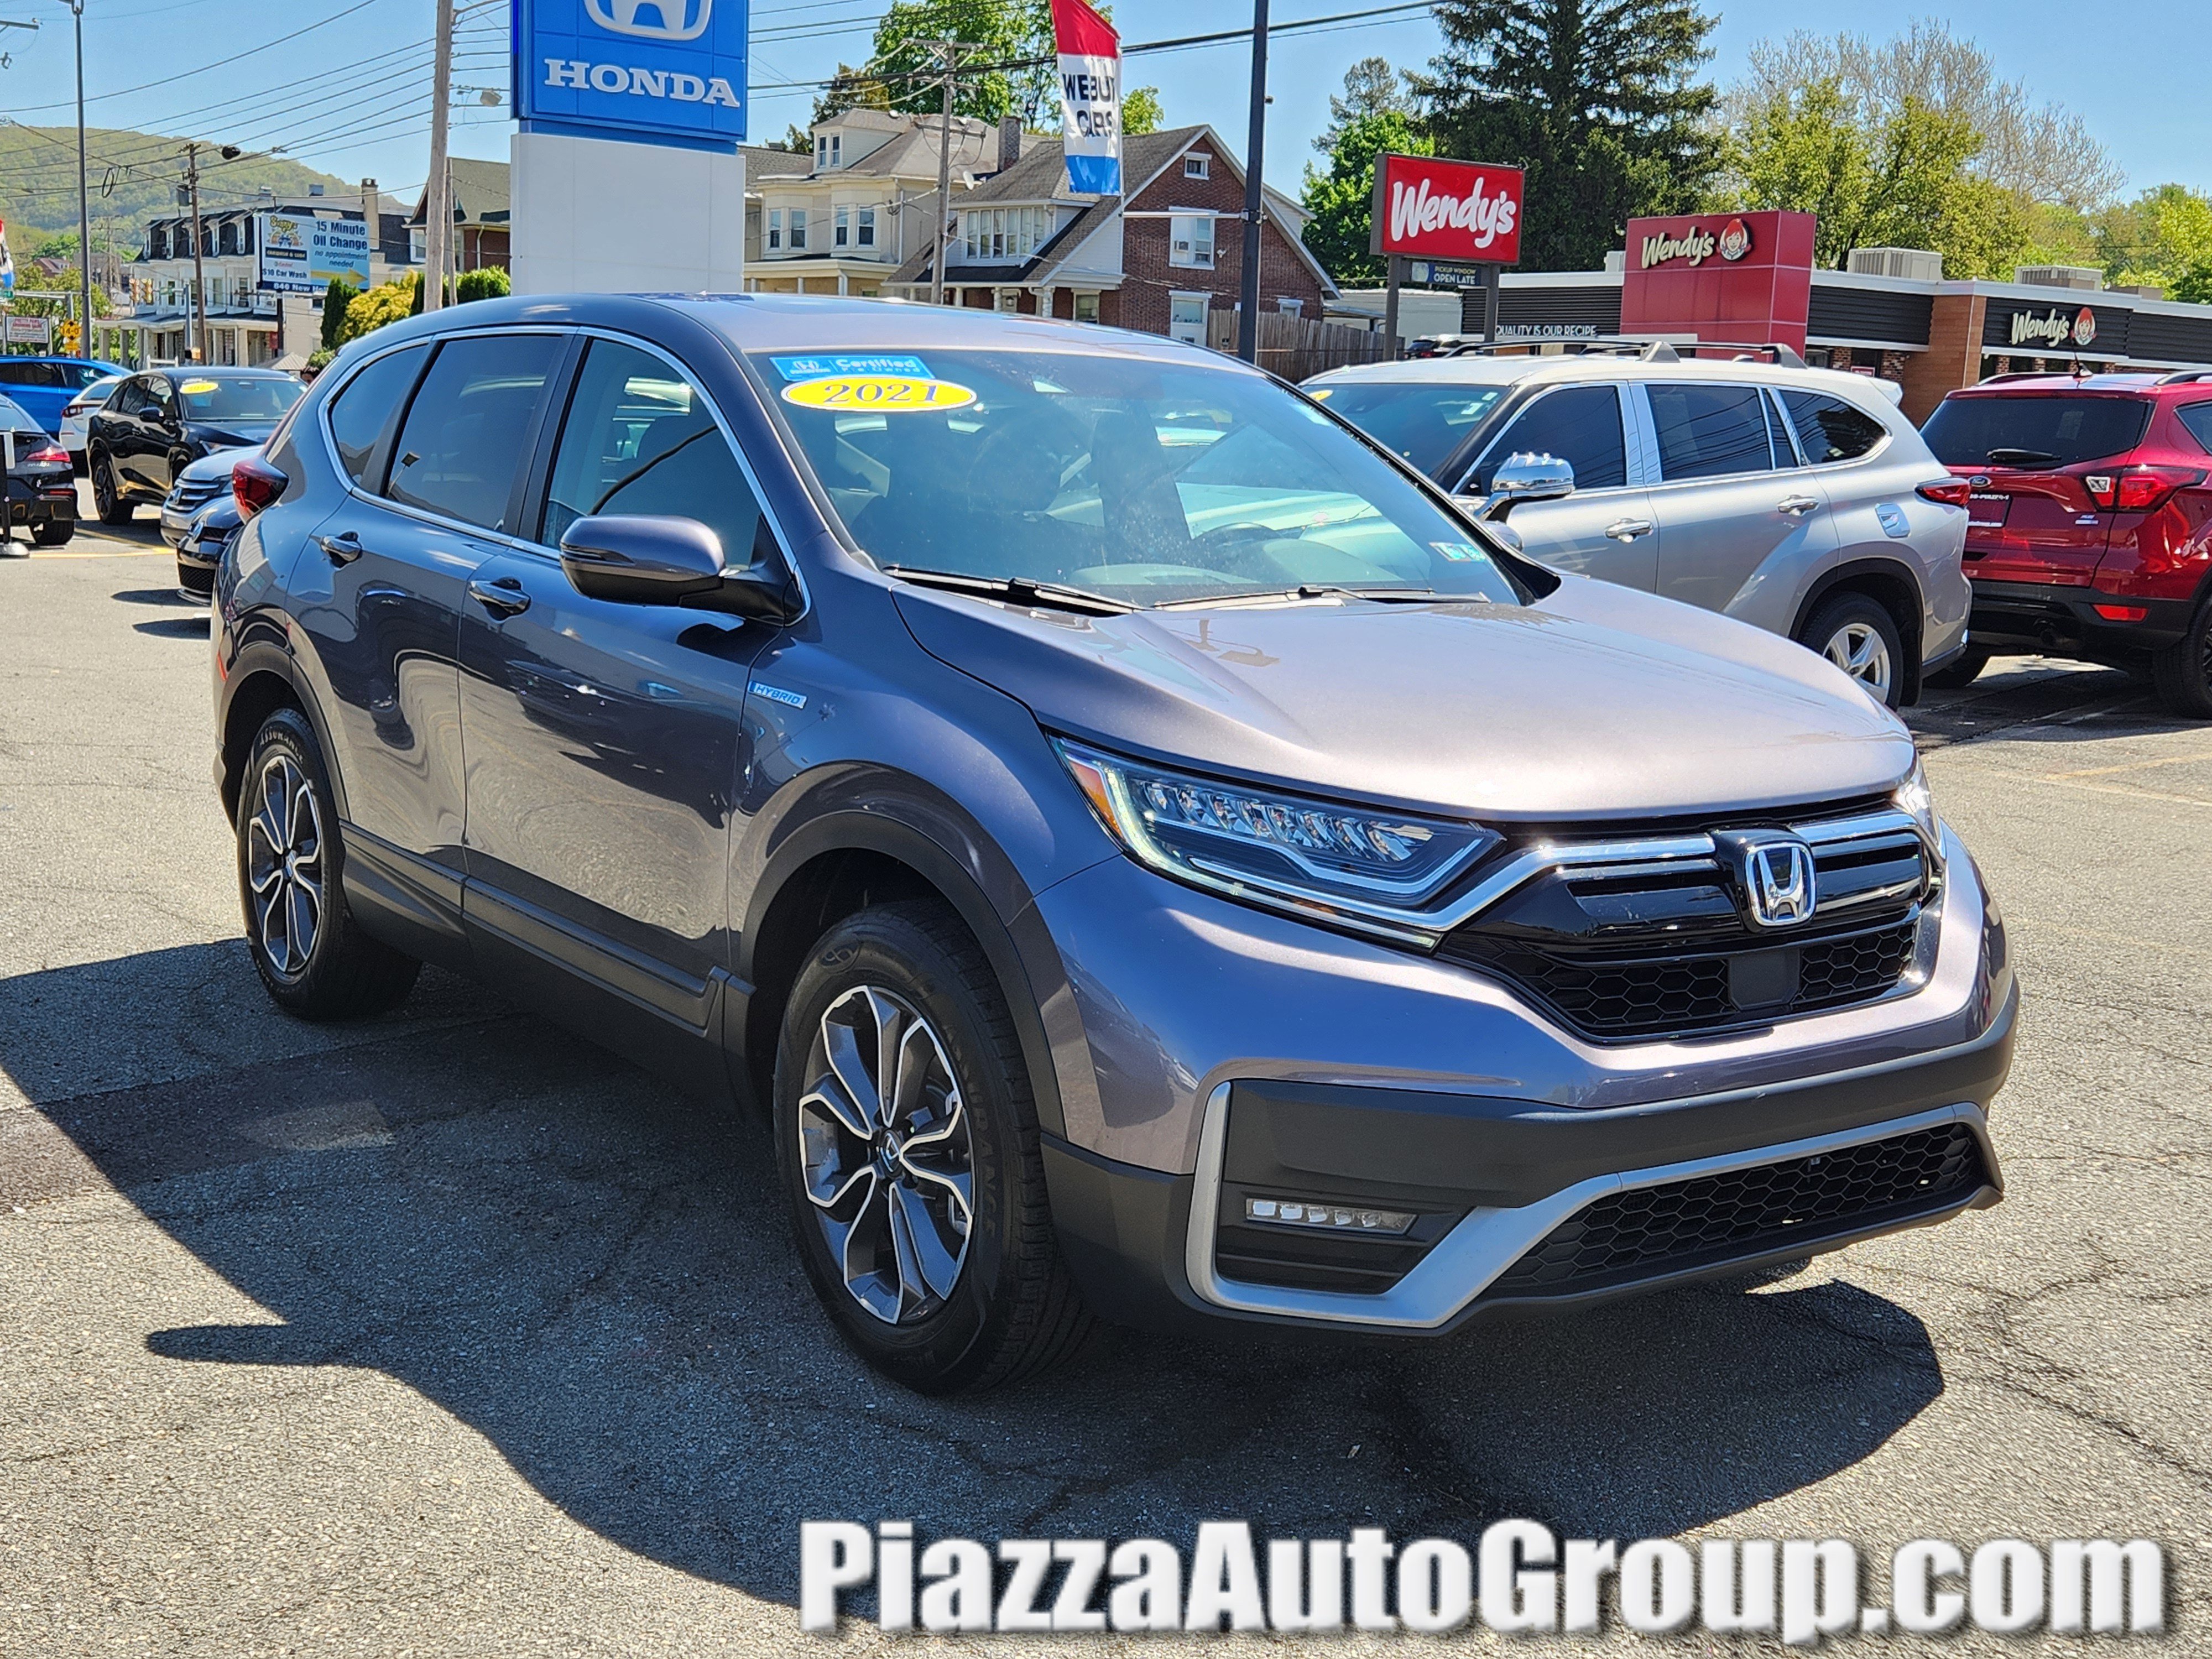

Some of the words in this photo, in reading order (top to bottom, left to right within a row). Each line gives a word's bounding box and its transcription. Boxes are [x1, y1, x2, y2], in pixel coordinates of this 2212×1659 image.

[544, 58, 740, 108] HONDA
[1076, 109, 1113, 139] CARS
[1391, 177, 1516, 249] Wendy's
[316, 221, 327, 232] 15
[331, 222, 366, 236] Minute
[313, 234, 326, 247] Oil
[330, 236, 368, 251] Change
[1641, 226, 1715, 269] Wendy's
[325, 251, 368, 260] appointment
[292, 284, 310, 292] New
[1433, 273, 1455, 283] OPEN
[1457, 275, 1475, 285] LATE
[1495, 325, 1532, 336] QUALITY
[1533, 325, 1541, 336] IS
[1542, 325, 1563, 336] OUR
[1564, 325, 1598, 336] RECIPE
[2011, 308, 2070, 347] Wendy's
[836, 358, 917, 368] Certified
[823, 383, 939, 403] 2021
[756, 685, 801, 704] HYBRID
